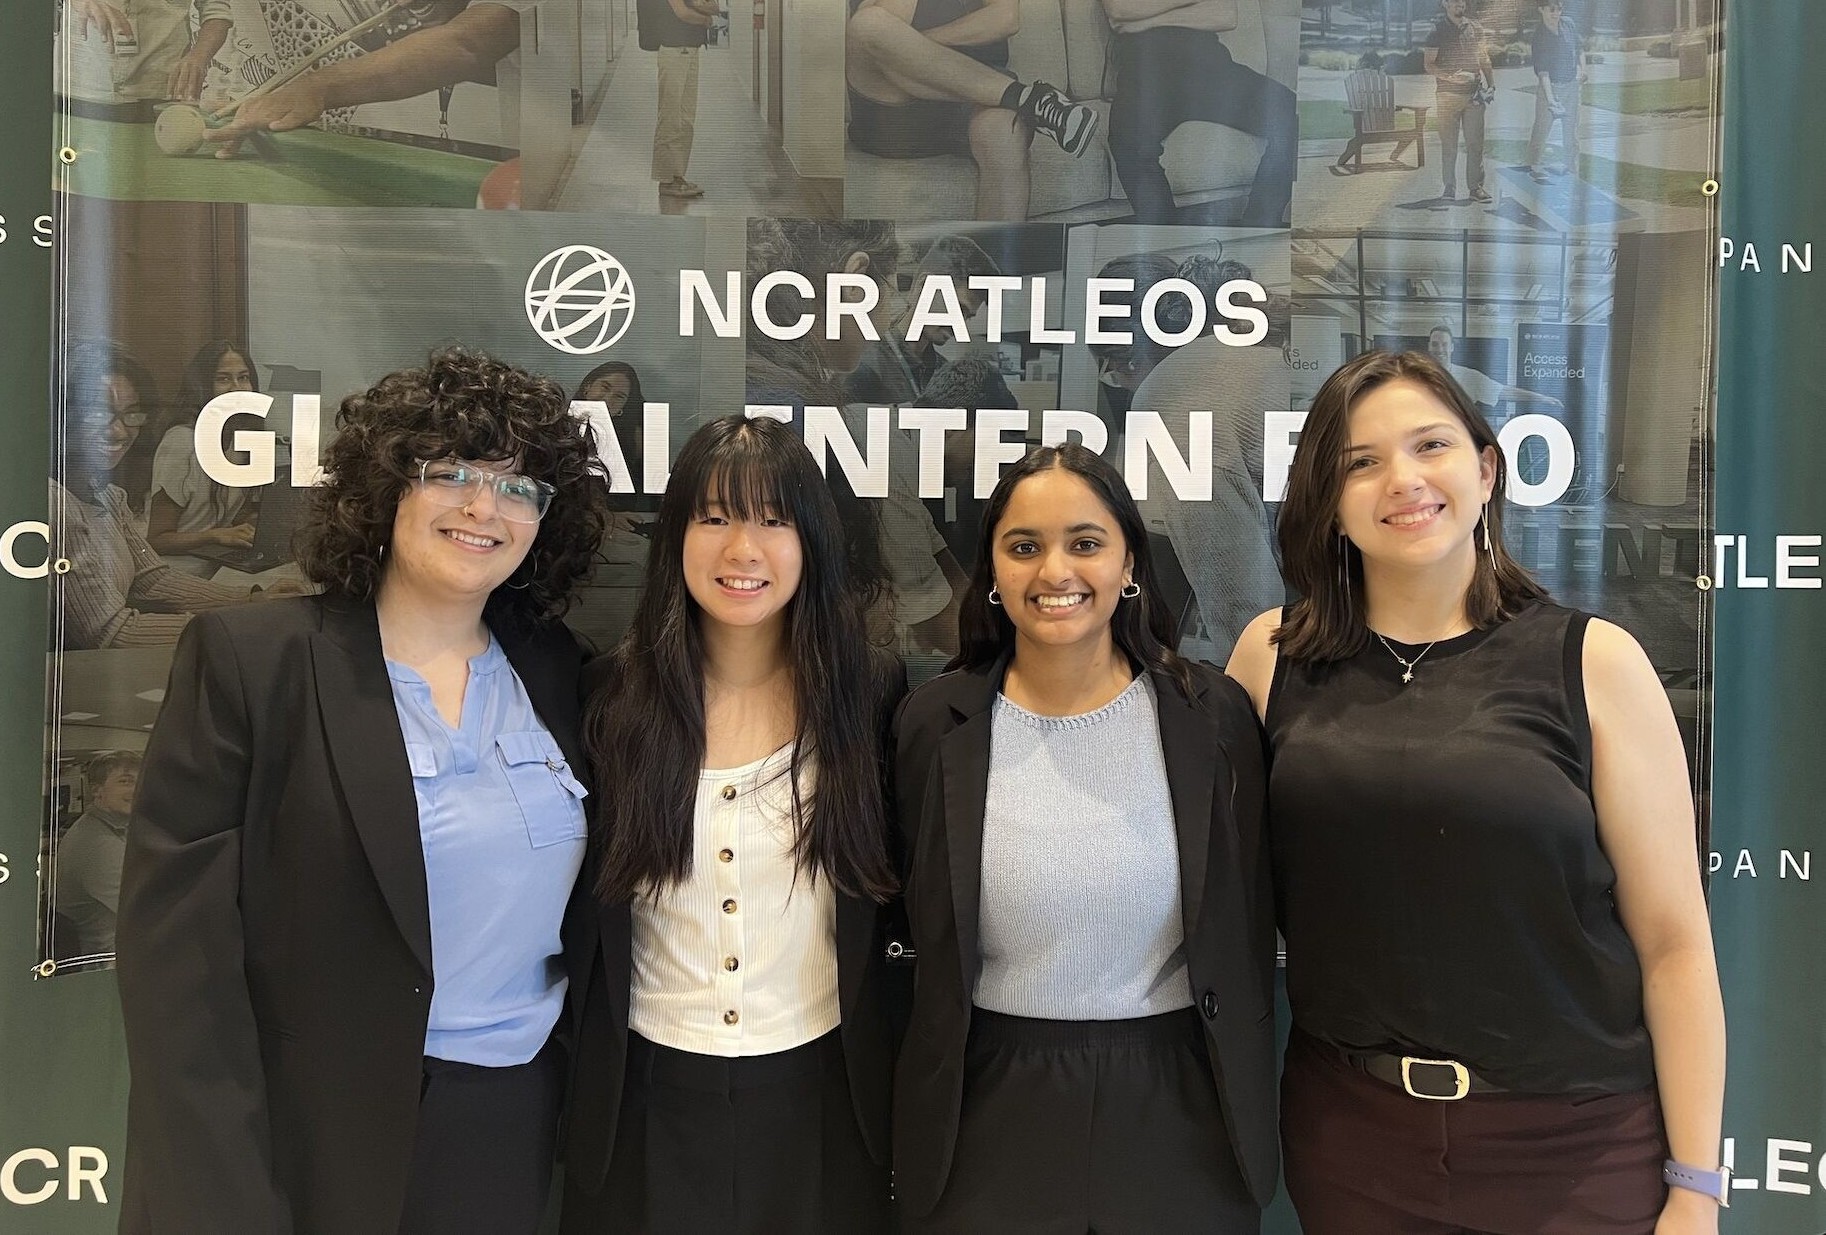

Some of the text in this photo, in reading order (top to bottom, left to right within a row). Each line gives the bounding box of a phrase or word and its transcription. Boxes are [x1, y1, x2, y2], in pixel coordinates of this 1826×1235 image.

[1719, 236, 1812, 273] PAN
[679, 269, 1269, 346] NCR ATLEOS
[1524, 352, 1568, 365] Access
[1524, 366, 1586, 380] Expanded
[194, 390, 1575, 507] GLAL NTERN EO
[1714, 534, 1822, 589] TLE
[0, 1146, 108, 1205] CR
[1723, 1137, 1826, 1196] LE
